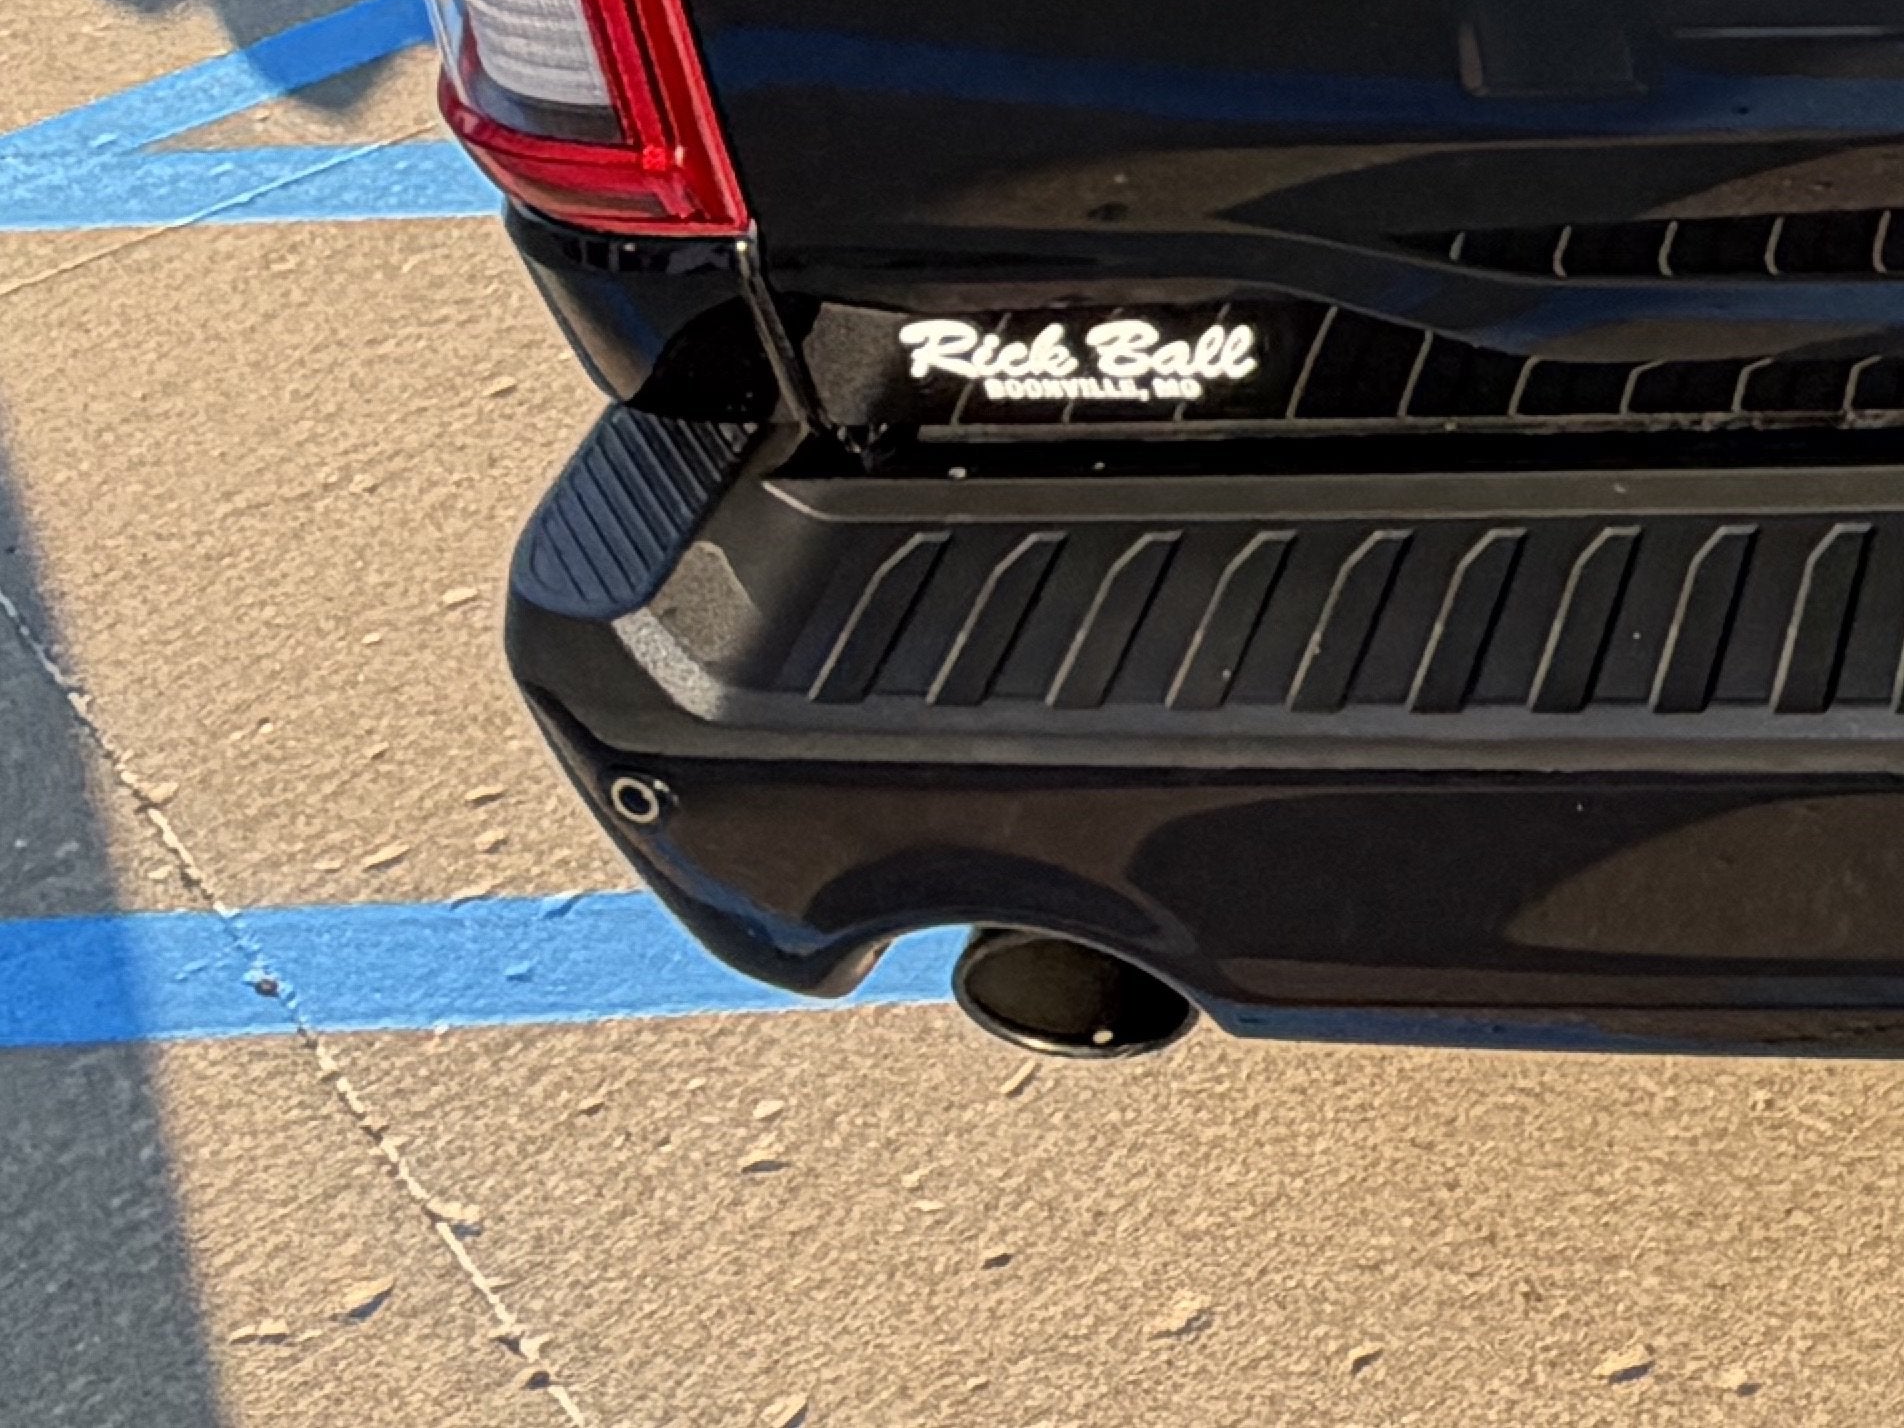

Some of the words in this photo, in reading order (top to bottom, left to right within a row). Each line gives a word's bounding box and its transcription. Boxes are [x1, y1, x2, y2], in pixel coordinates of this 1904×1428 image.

[899, 317, 1080, 379] Rick
[1084, 318, 1259, 379] Ball
[984, 377, 1149, 403] BOONVILLE,
[1154, 378, 1204, 401] MO
